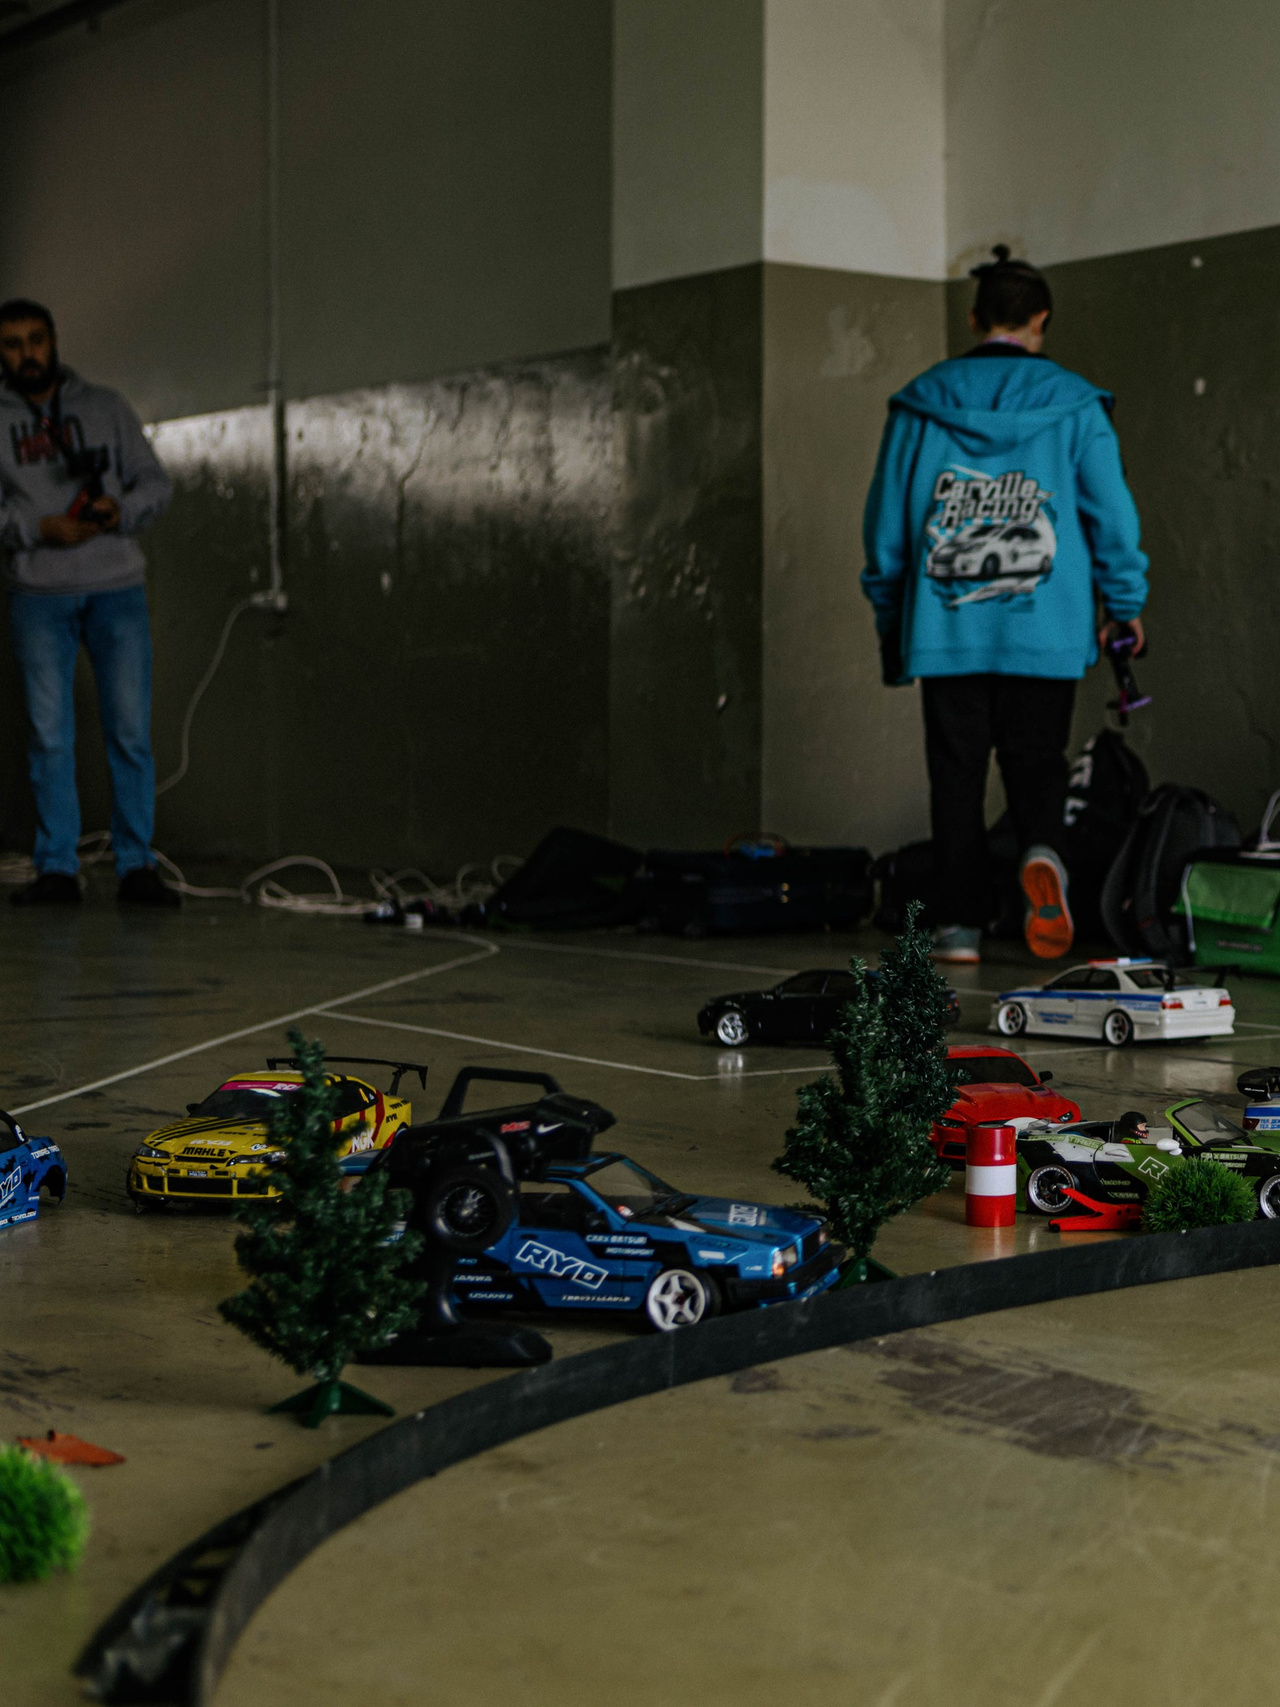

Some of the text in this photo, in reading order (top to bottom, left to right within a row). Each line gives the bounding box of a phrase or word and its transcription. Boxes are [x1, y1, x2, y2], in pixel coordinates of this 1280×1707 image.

[934, 471, 1038, 502] Carville
[940, 498, 1039, 527] Racing
[183, 1147, 227, 1157] MAHLE
[352, 1129, 374, 1154] NGK
